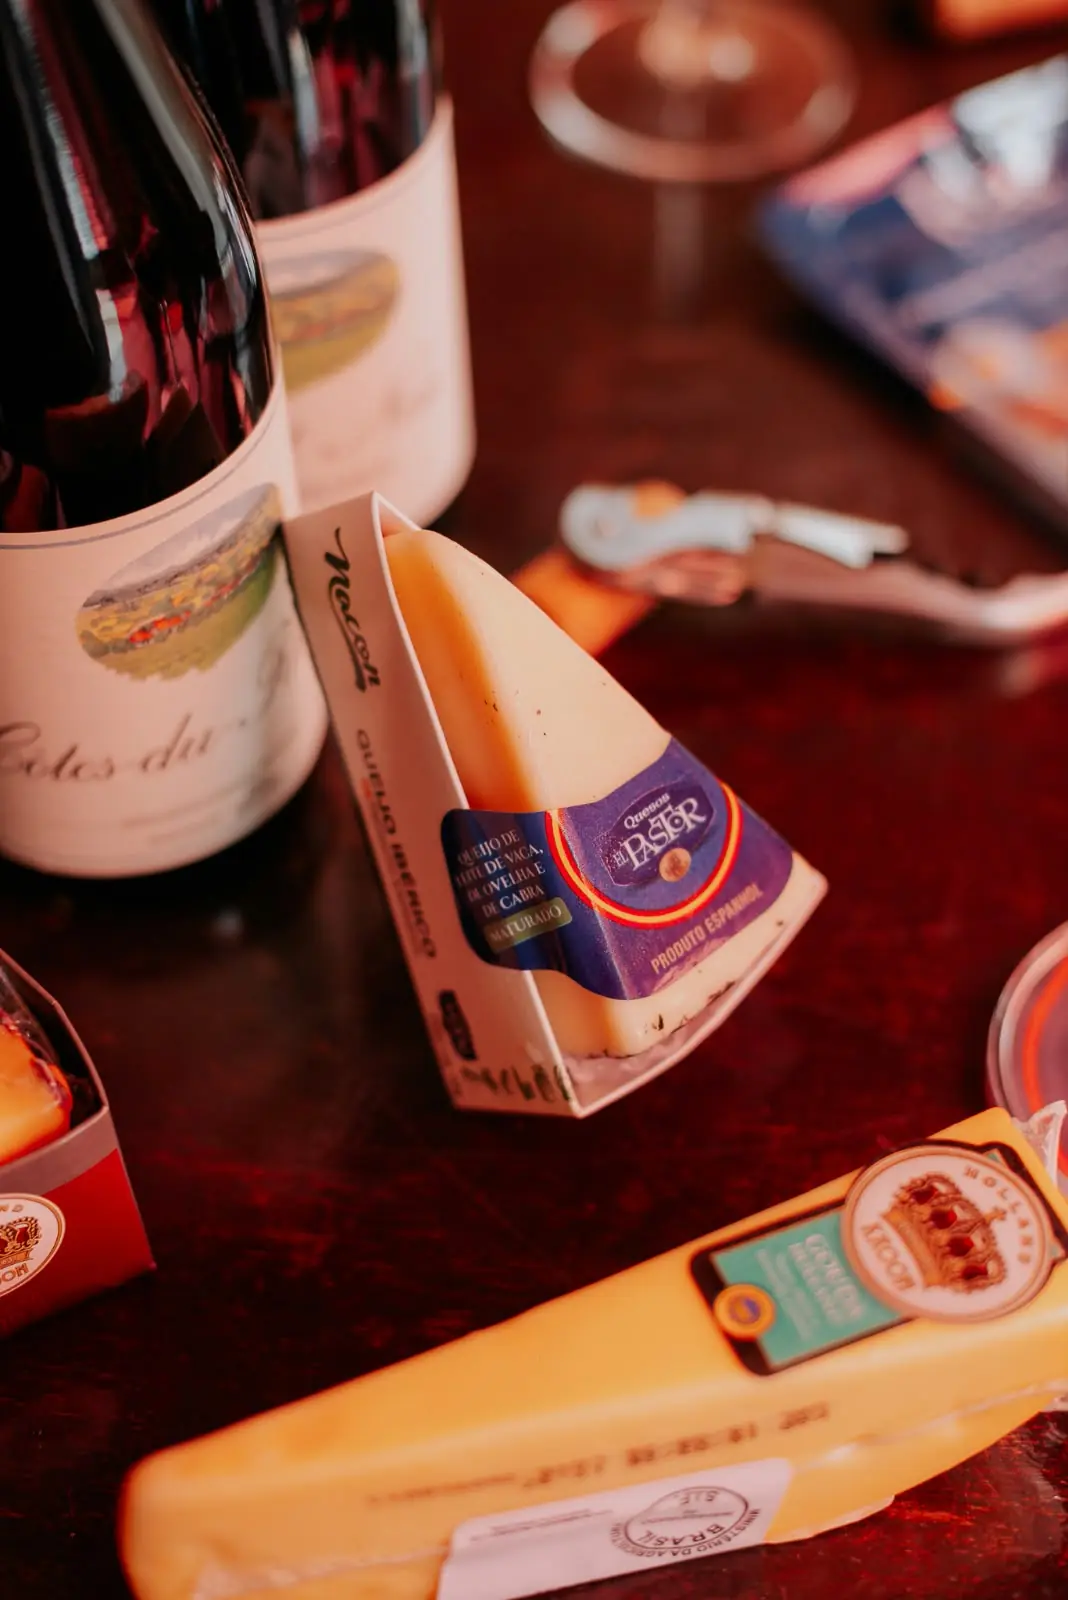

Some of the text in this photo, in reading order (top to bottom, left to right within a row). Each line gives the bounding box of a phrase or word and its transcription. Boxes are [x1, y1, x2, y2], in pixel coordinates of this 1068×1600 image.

[357, 730, 396, 835] QUEIJO
[624, 793, 671, 830] Quesos
[458, 829, 520, 866] QUEIJO DE
[485, 858, 506, 875] DE
[506, 844, 544, 864] VACA,
[613, 850, 629, 868] EL
[482, 867, 536, 891] OVELHA
[535, 861, 546, 876] E
[482, 884, 545, 918] DE CABRA
[490, 905, 562, 942] MATURADO
[651, 882, 764, 974] PRODUTO ESPANHOL
[962, 1164, 1033, 1264] HOLLAND
[637, 1523, 725, 1547] BRASIL
